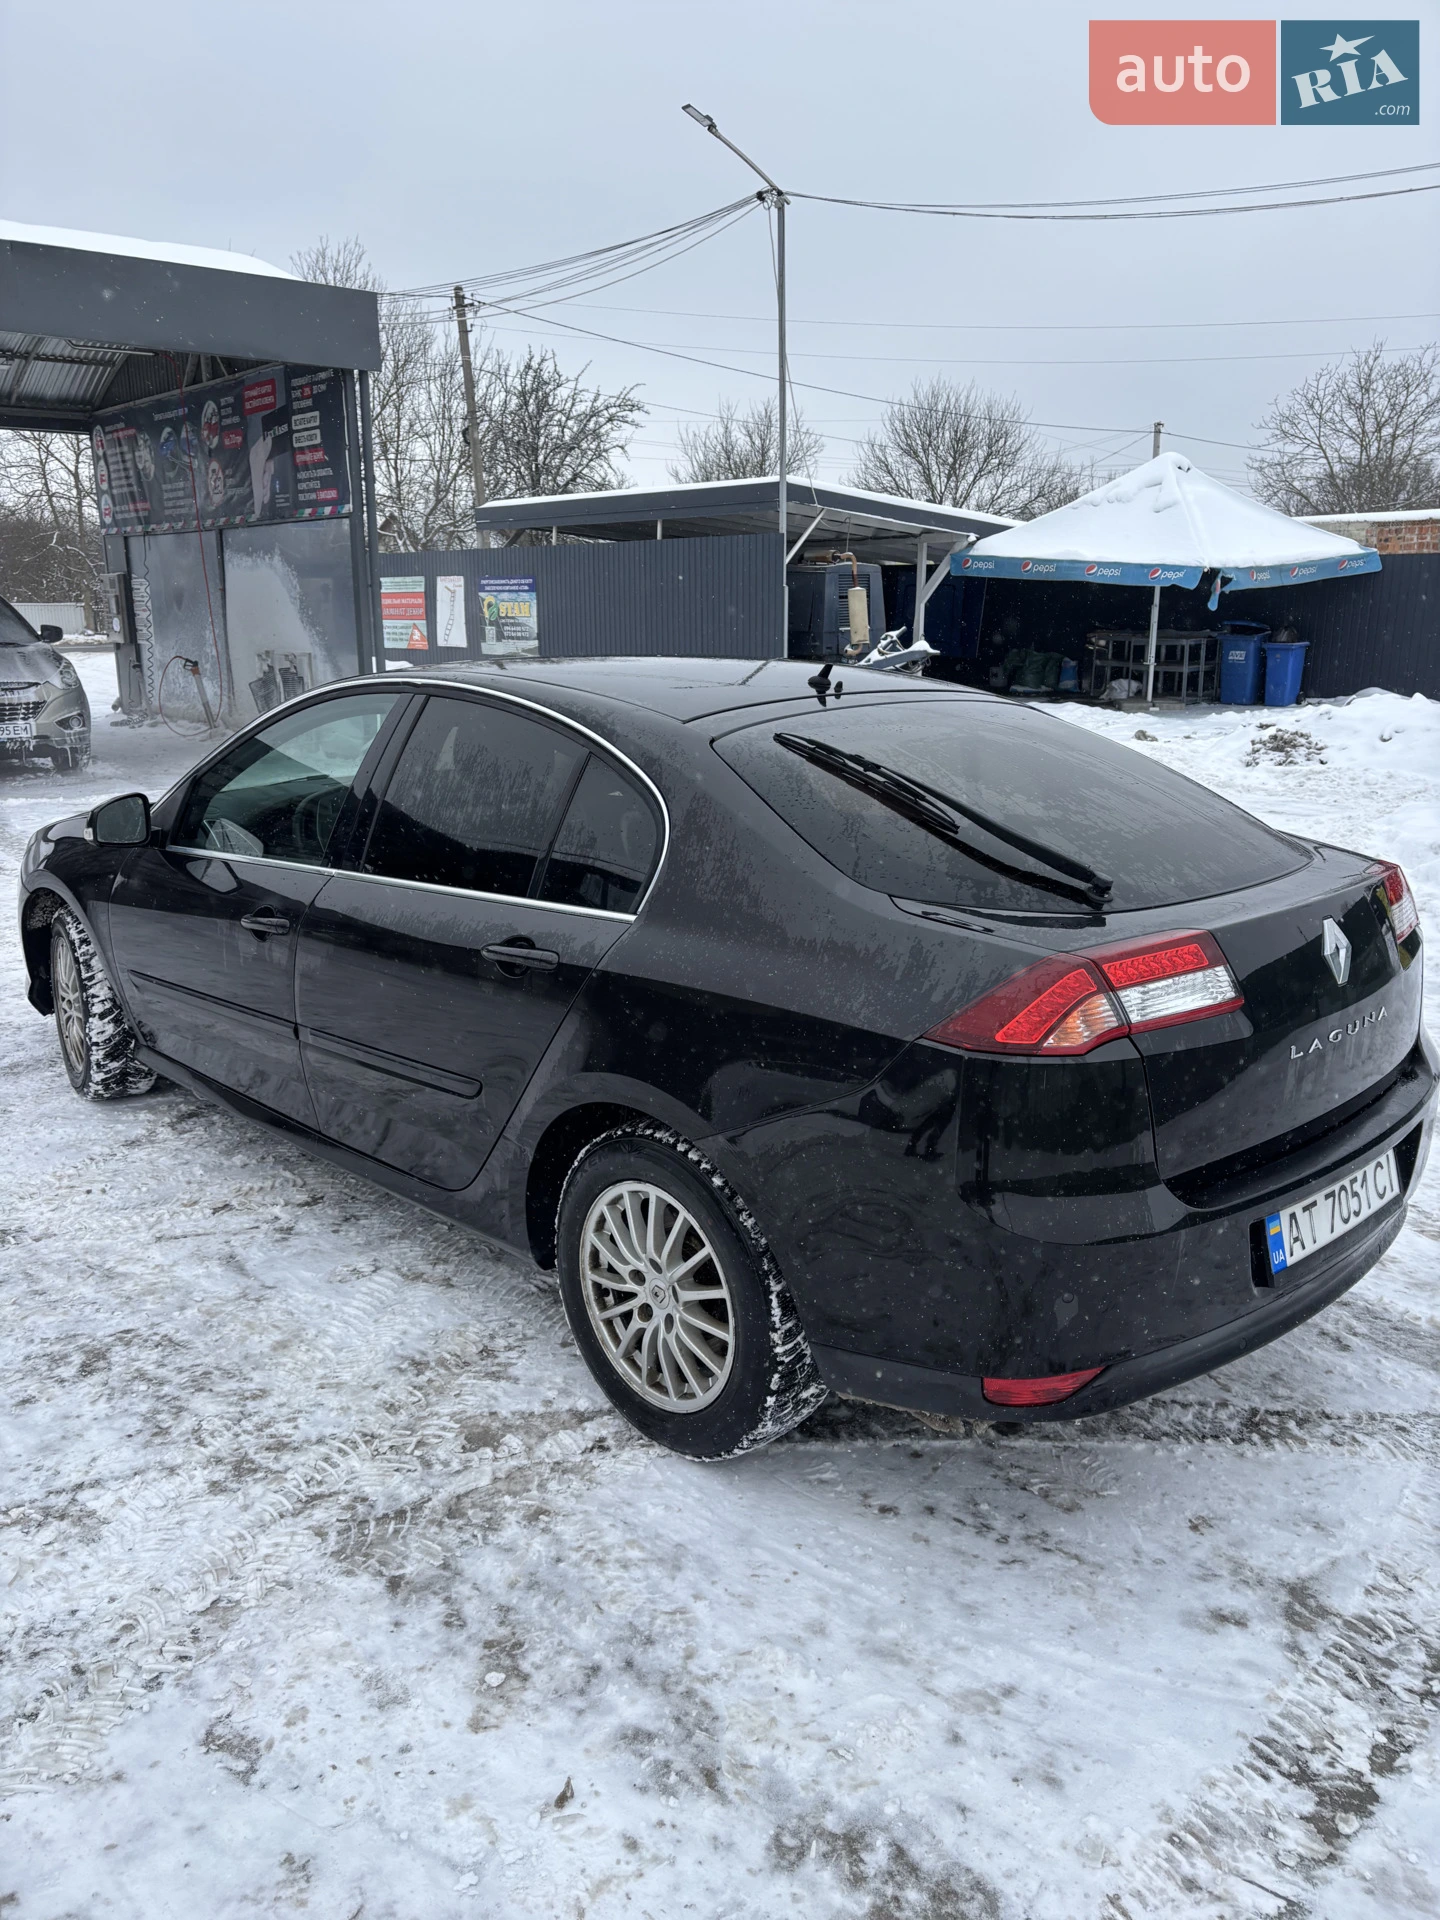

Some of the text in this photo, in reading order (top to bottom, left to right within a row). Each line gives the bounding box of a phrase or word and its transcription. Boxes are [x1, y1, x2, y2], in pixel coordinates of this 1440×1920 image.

[973, 560, 995, 570] pepsi
[1032, 563, 1057, 573] pepsi
[1298, 564, 1317, 576] pepsi
[1097, 567, 1122, 577] pepsi
[1256, 570, 1271, 581] pepsi
[13, 725, 28, 735] EM
[1290, 1006, 1388, 1060] LAGUNA
[1288, 1154, 1394, 1258] AT 7051 CI
[1273, 1252, 1286, 1264] UA
